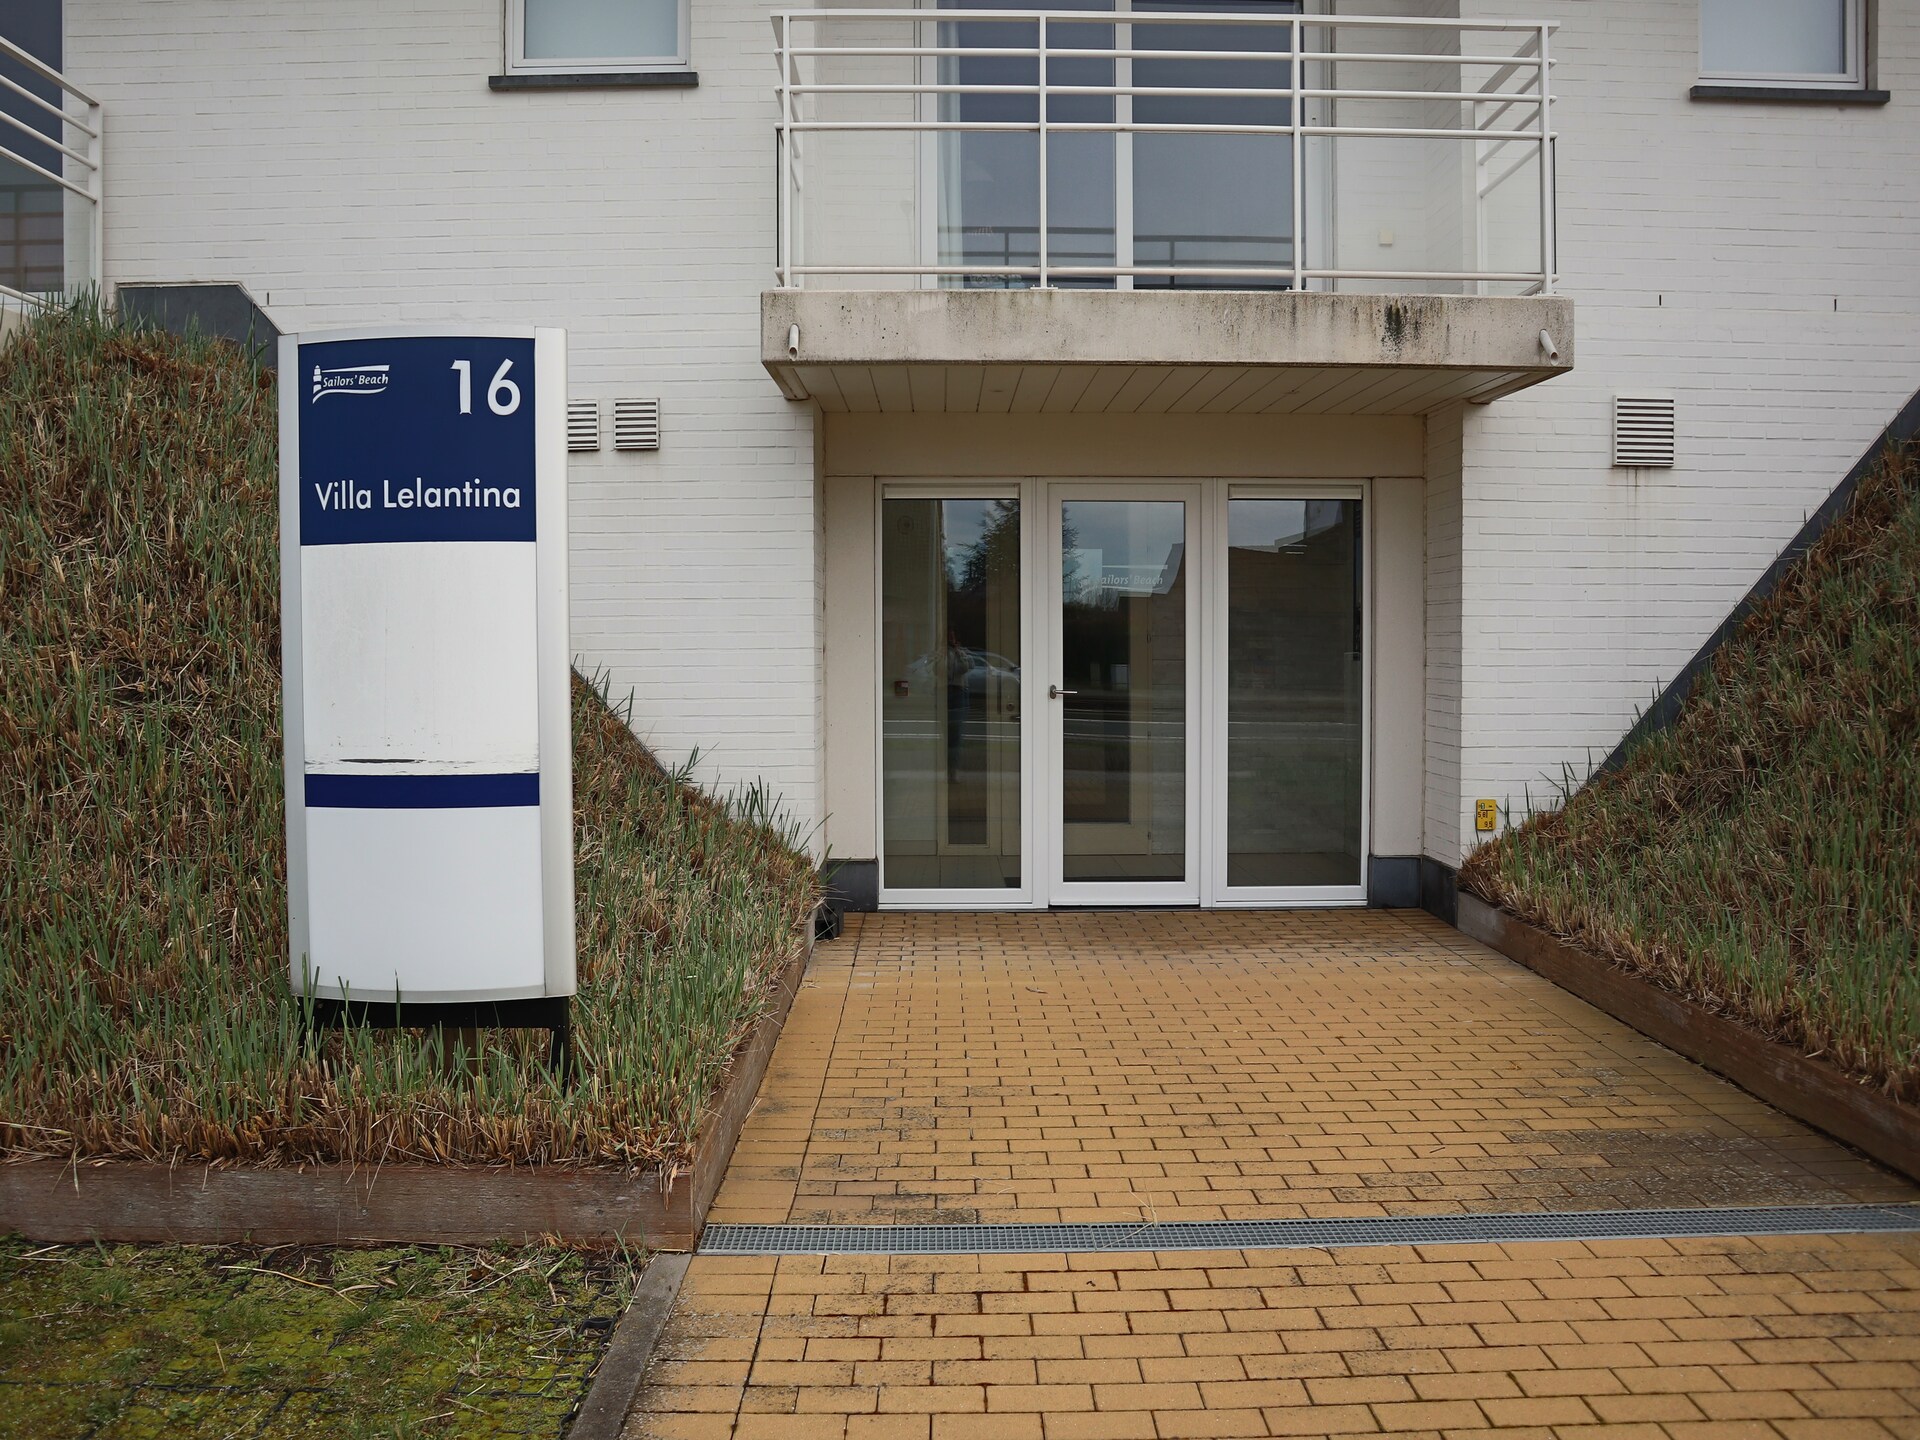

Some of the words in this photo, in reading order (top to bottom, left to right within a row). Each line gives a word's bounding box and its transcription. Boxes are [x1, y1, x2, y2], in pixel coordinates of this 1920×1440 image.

[323, 374, 358, 388] Sailors'
[358, 373, 389, 385] Beach
[450, 358, 521, 416] 16
[315, 480, 372, 511] Villa
[383, 477, 521, 508] Lelantina
[1095, 574, 1133, 585] ailors'
[1134, 574, 1163, 585] Beach
